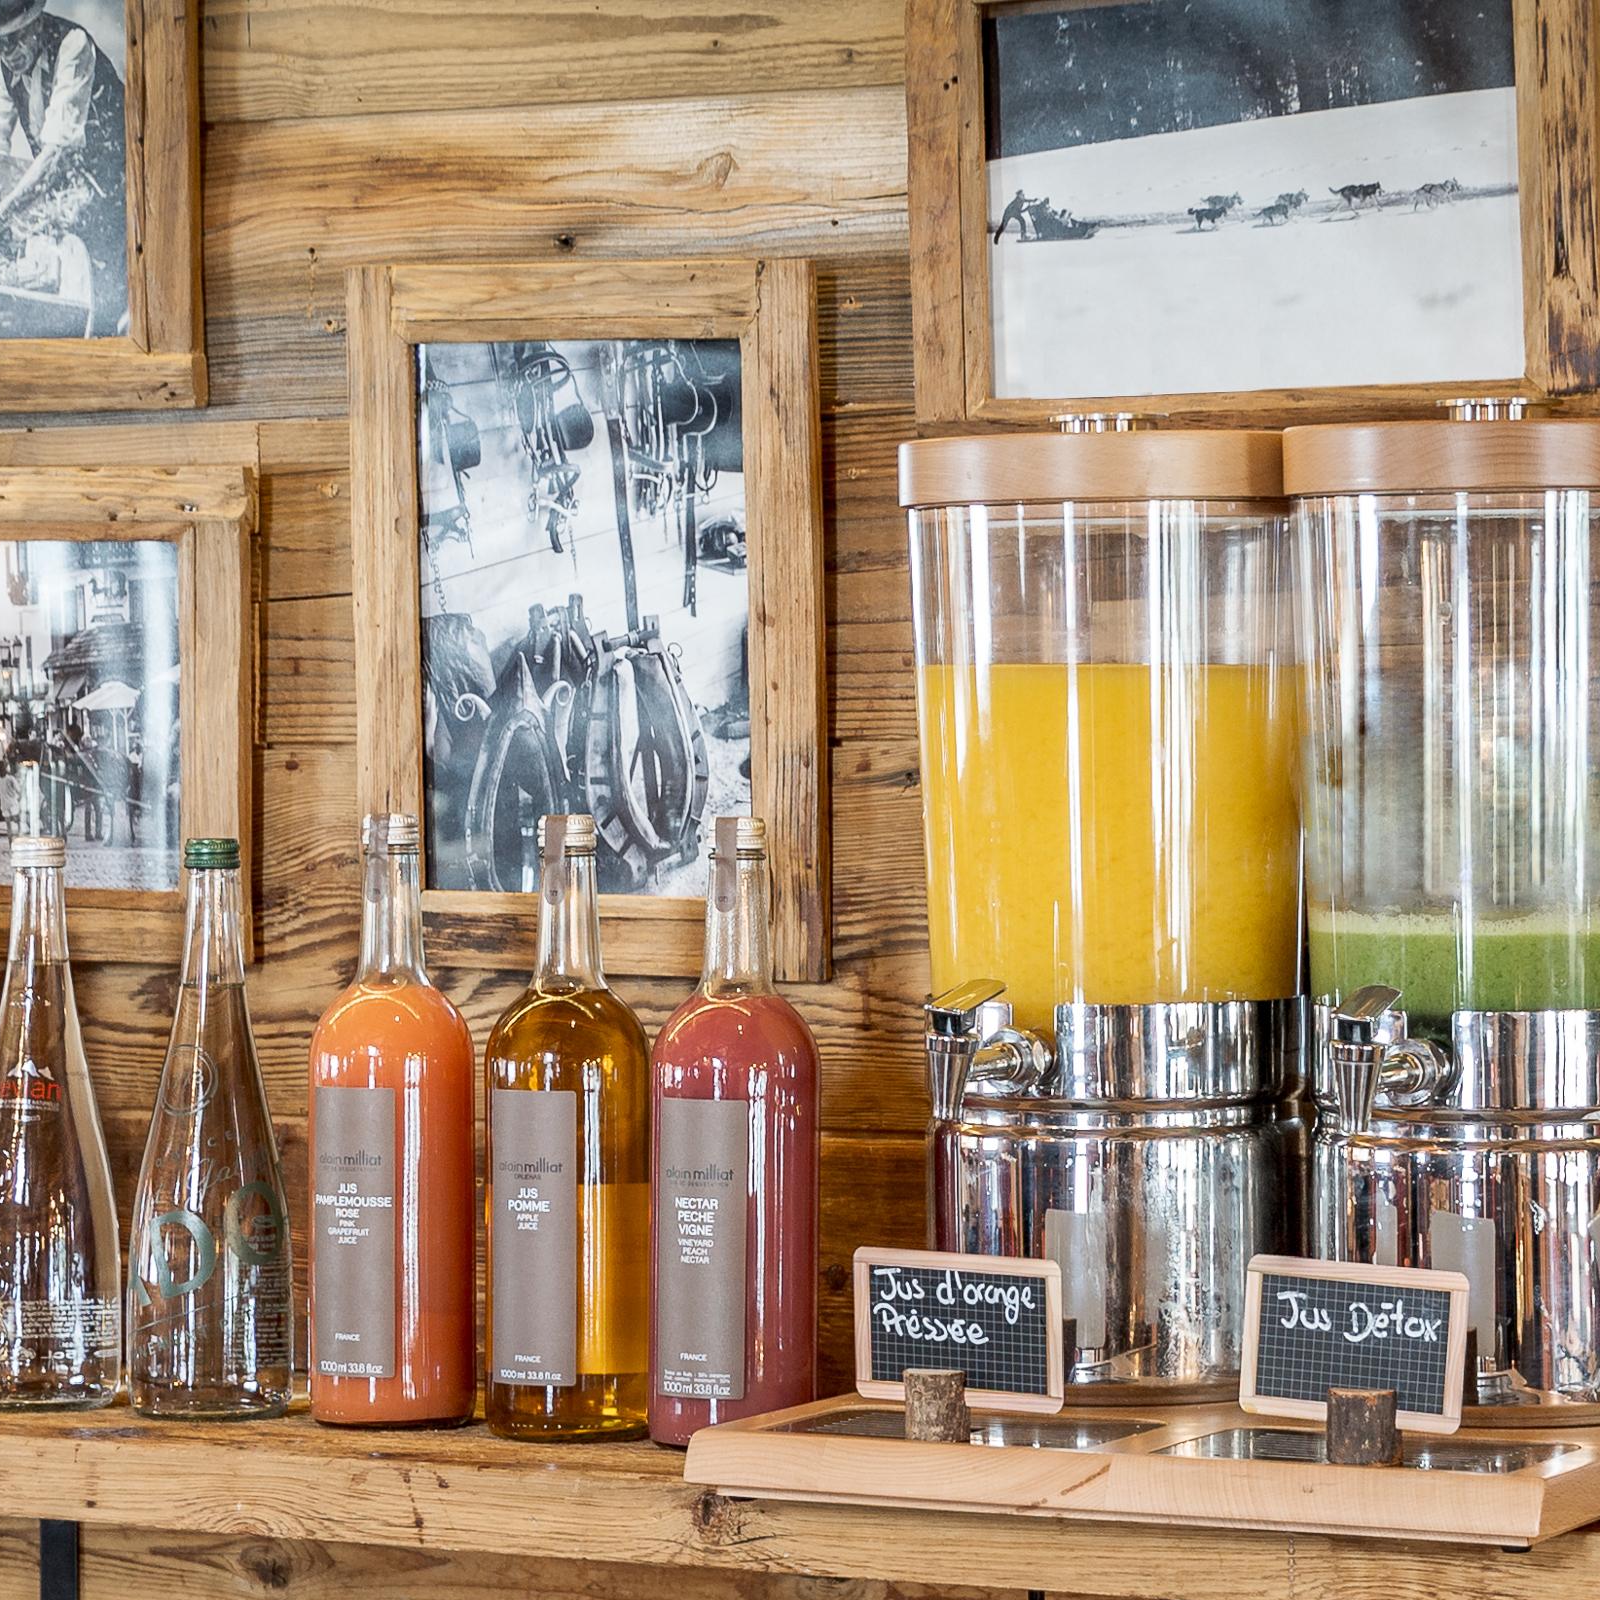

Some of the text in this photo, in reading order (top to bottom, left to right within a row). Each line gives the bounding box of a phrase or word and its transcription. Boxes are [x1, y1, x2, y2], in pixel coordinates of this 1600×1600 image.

[338, 1183, 358, 1194] JUS
[517, 1187, 538, 1199] JUS
[315, 1194, 393, 1208] PAMPLEMOUSSE
[507, 1199, 551, 1212] POMME
[674, 1197, 719, 1210] NECTAR
[335, 1208, 360, 1219] ROSE
[516, 1213, 540, 1222] APPLE
[677, 1210, 716, 1223] PECHE
[327, 1226, 370, 1237] GRAPEFRUIT
[517, 1222, 538, 1230] JUICE
[678, 1223, 714, 1236] VIGNE
[338, 1236, 358, 1245] JUICE
[677, 1238, 715, 1249] VINEYARD
[682, 1246, 709, 1256] PEACH
[680, 1255, 711, 1265] NECTAR
[873, 1267, 1036, 1325] Jus d'orange
[1276, 1290, 1333, 1332] Jus
[334, 1332, 361, 1342] FRANCE
[513, 1354, 542, 1364] FRANCE
[679, 1352, 708, 1362] FRANCE
[663, 1381, 682, 1393] 1000
